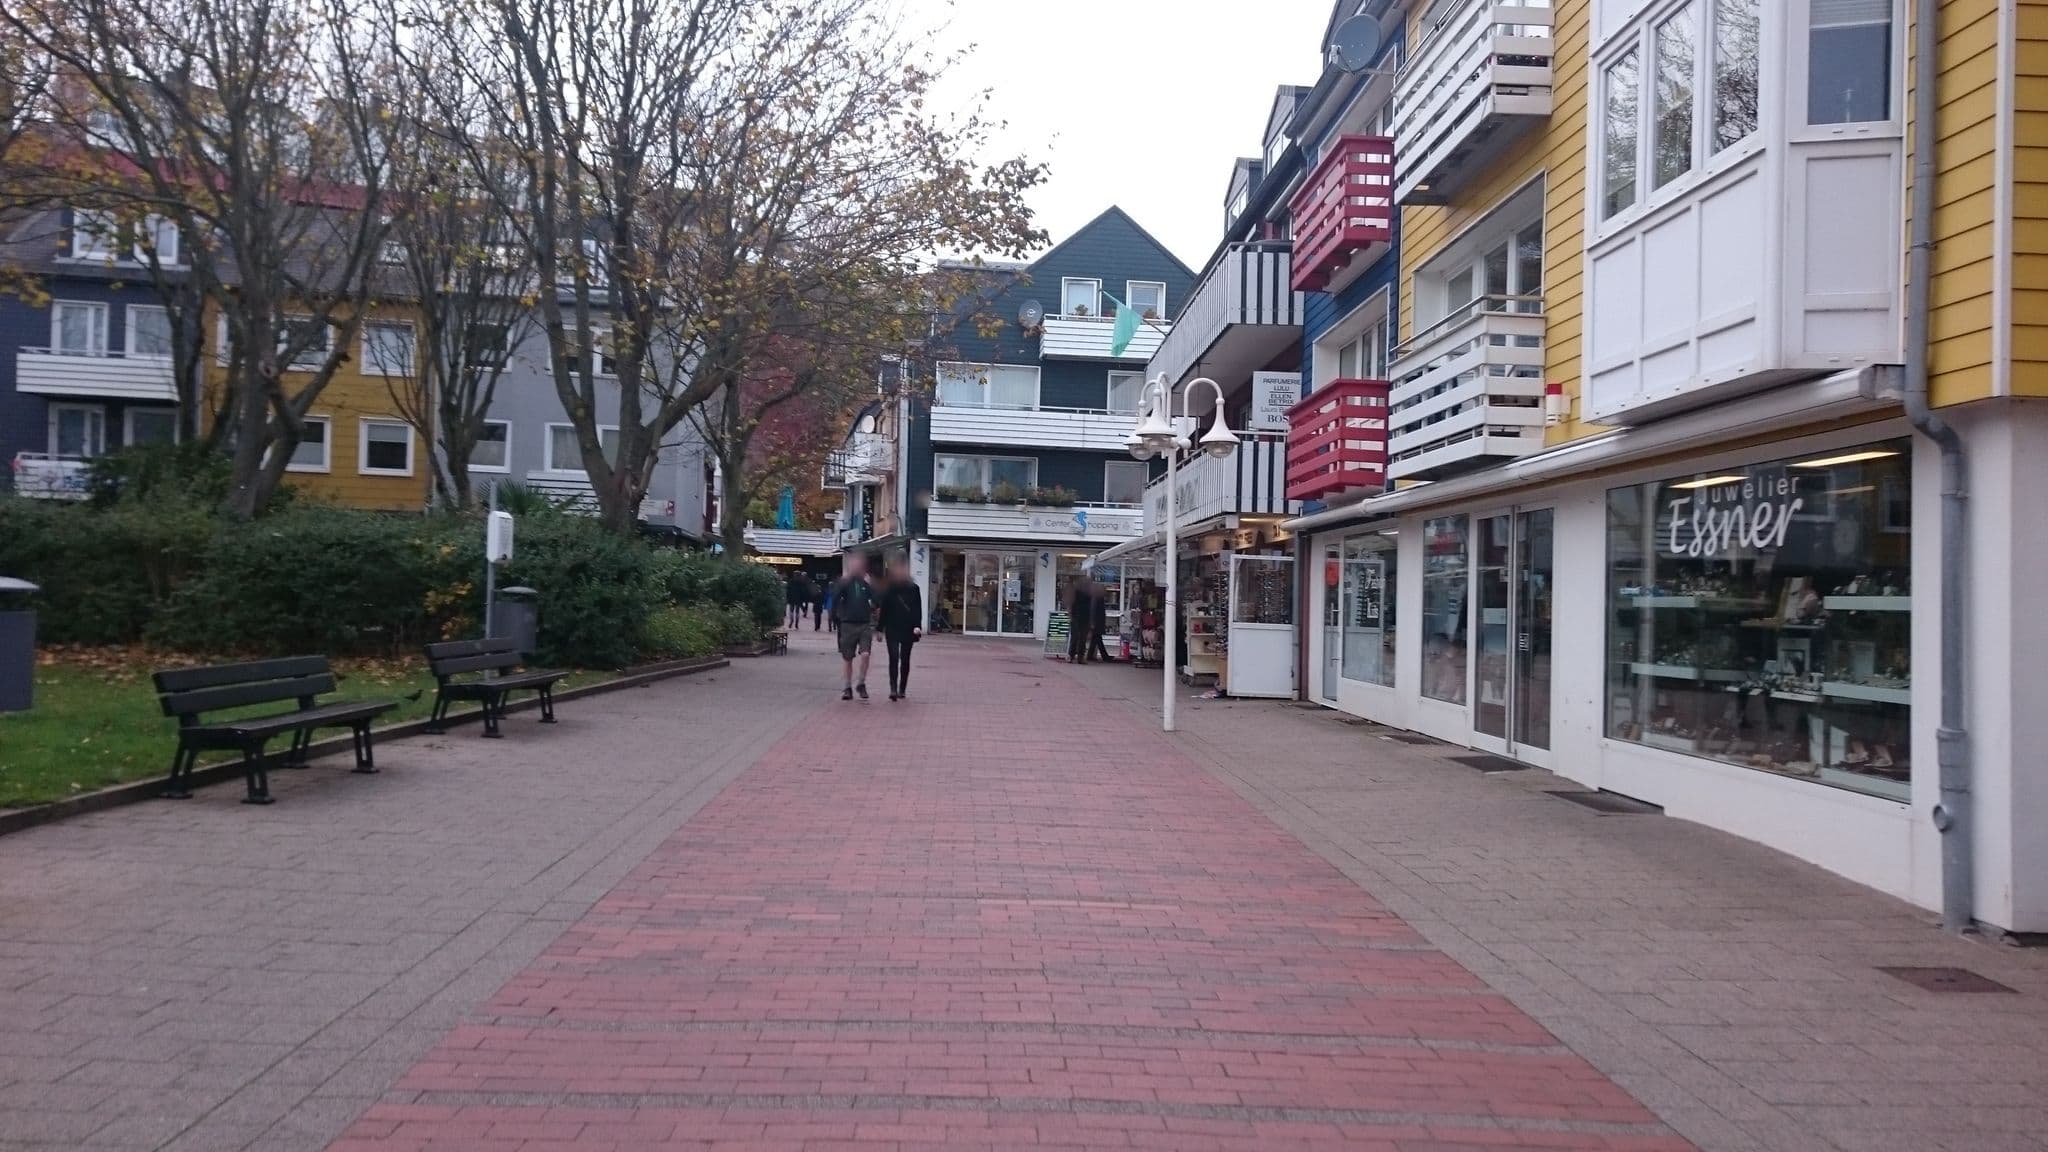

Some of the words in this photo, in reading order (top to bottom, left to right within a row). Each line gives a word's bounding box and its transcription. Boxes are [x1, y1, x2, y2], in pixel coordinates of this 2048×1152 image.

[1267, 415, 1289, 423] BOS
[1698, 476, 1800, 505] Juwelier
[1046, 520, 1069, 528] Center
[1668, 496, 1803, 558] Essner
